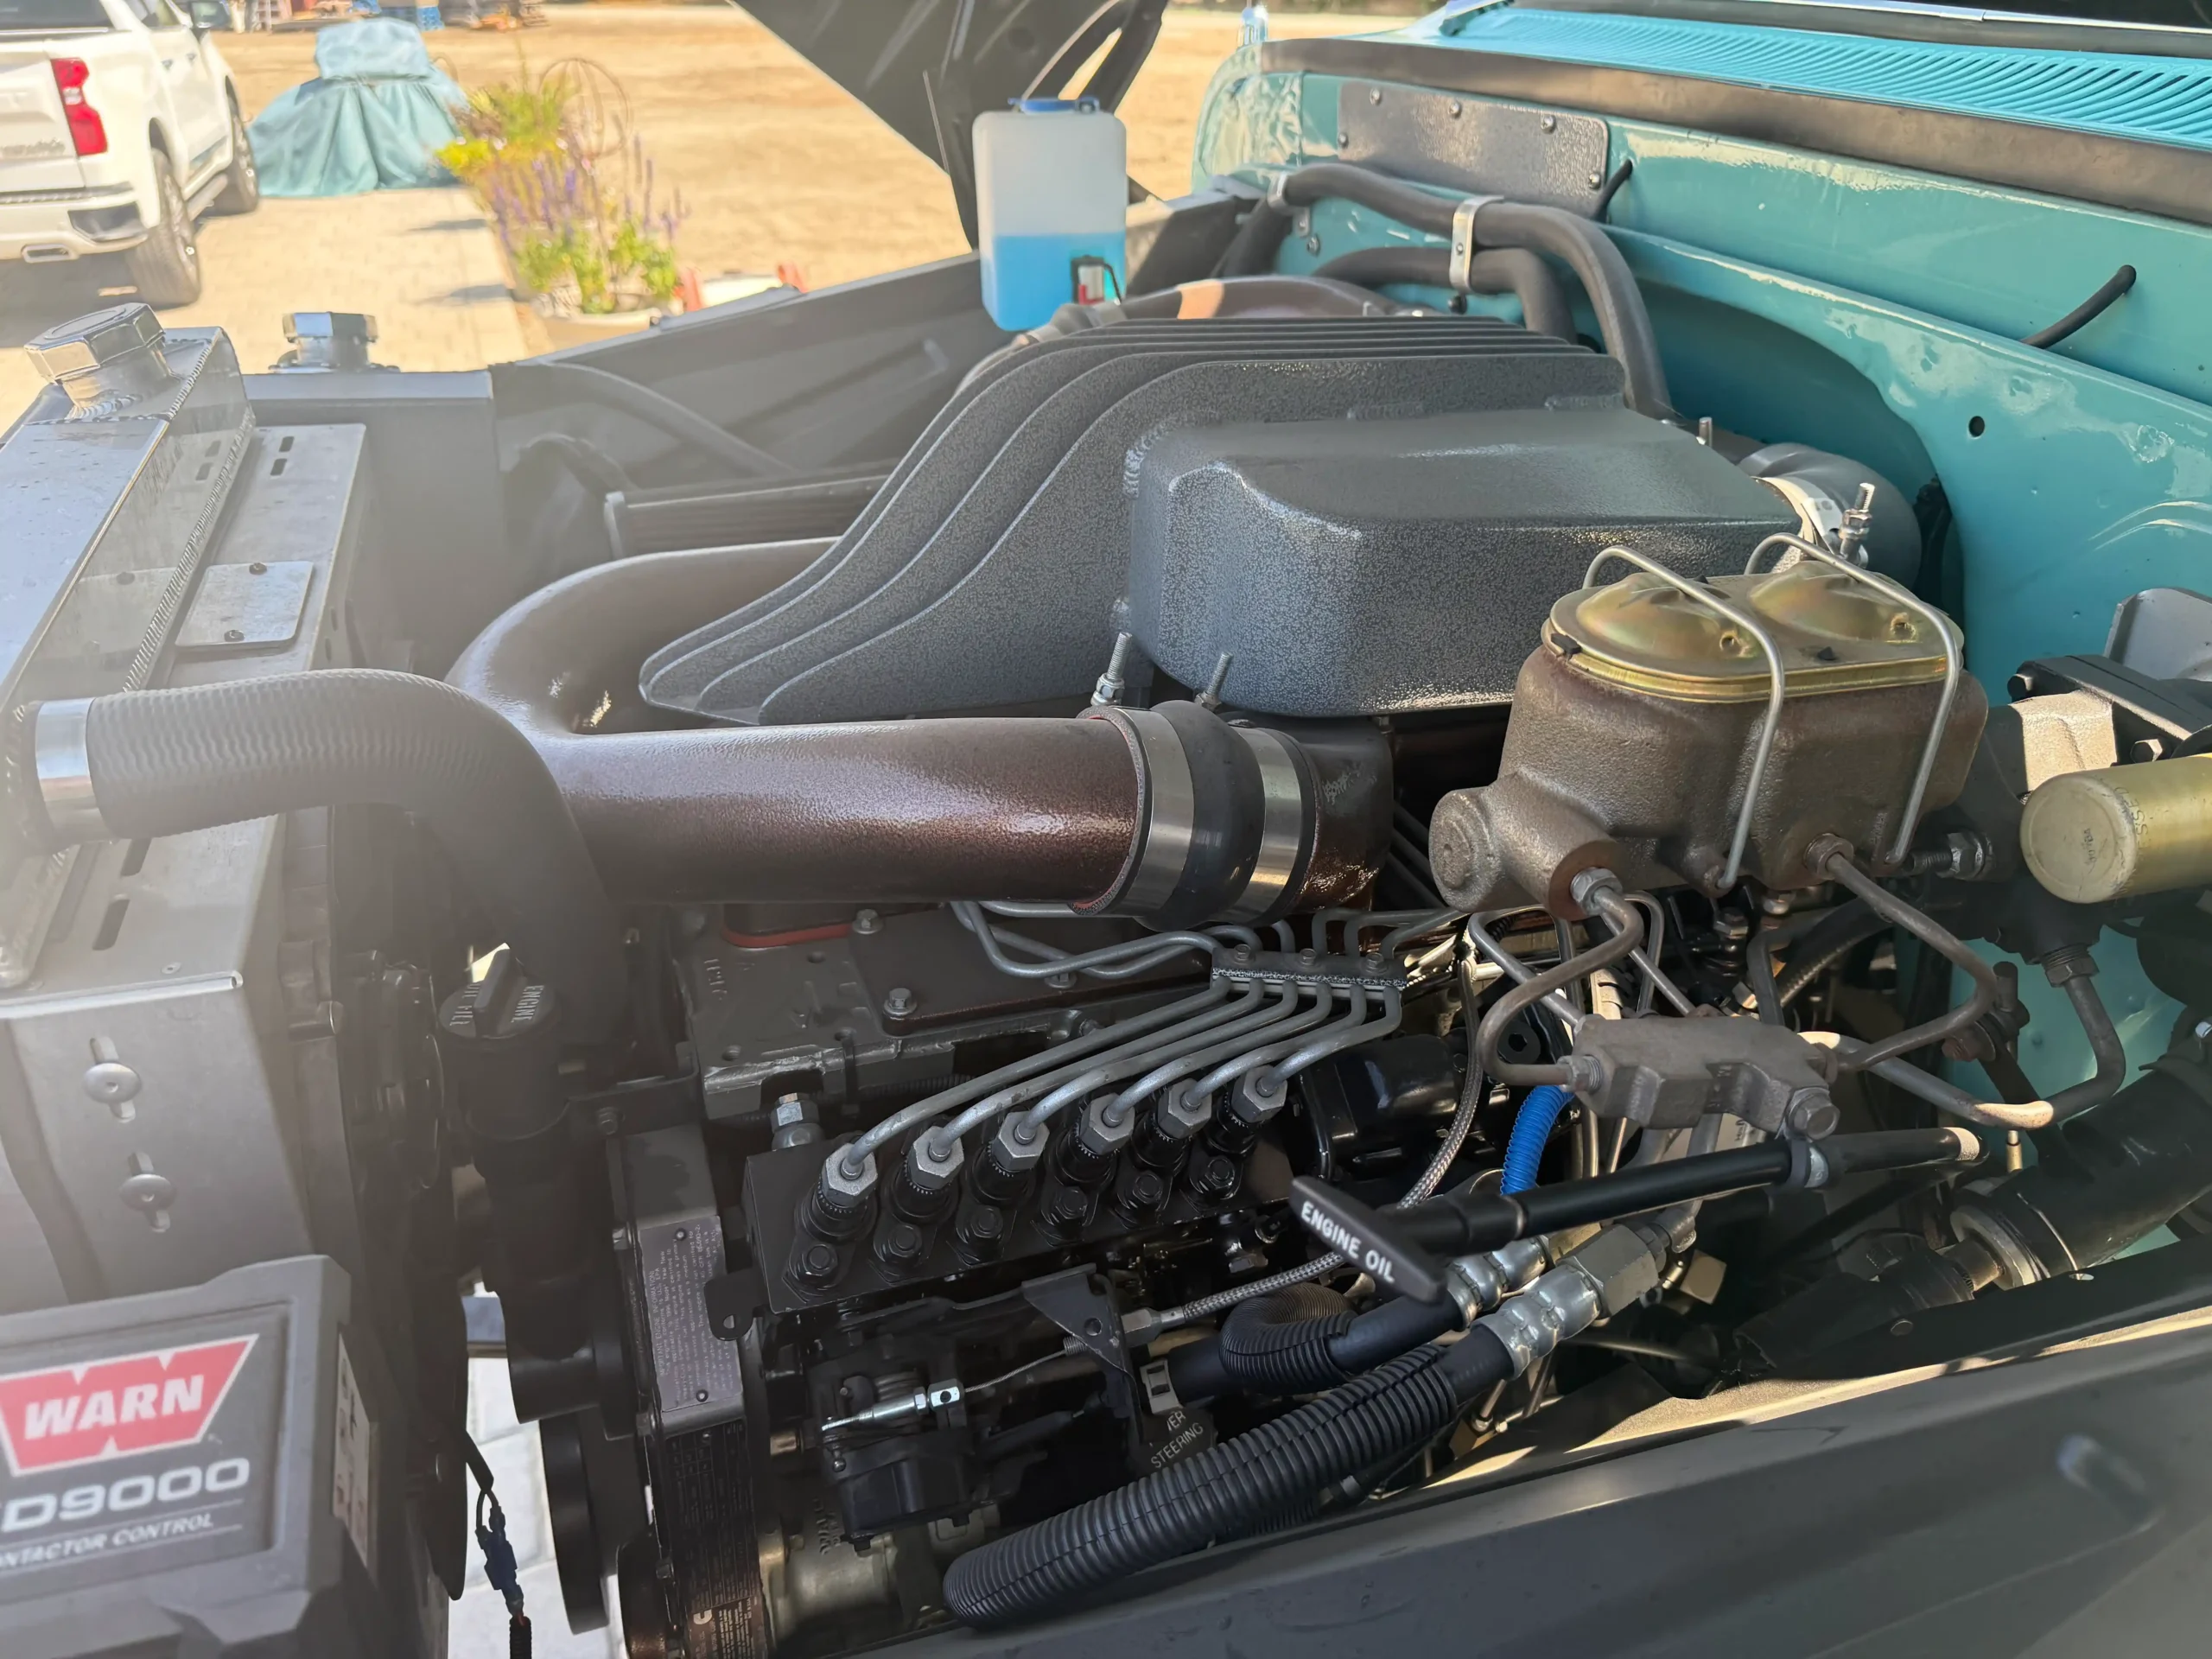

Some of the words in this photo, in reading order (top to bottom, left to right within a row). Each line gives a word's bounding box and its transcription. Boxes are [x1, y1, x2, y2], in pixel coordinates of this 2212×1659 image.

[448, 1004, 474, 1027] FILL
[510, 984, 545, 1023] ENGINE
[1300, 1200, 1362, 1260] ENGINE
[1364, 1249, 1395, 1284] OIL
[22, 1374, 205, 1441] WARN
[1150, 1422, 1204, 1469] STEERING
[0, 1457, 251, 1533] D9000
[0, 1533, 108, 1568] NTACTOR
[111, 1512, 214, 1547] CONTROL
